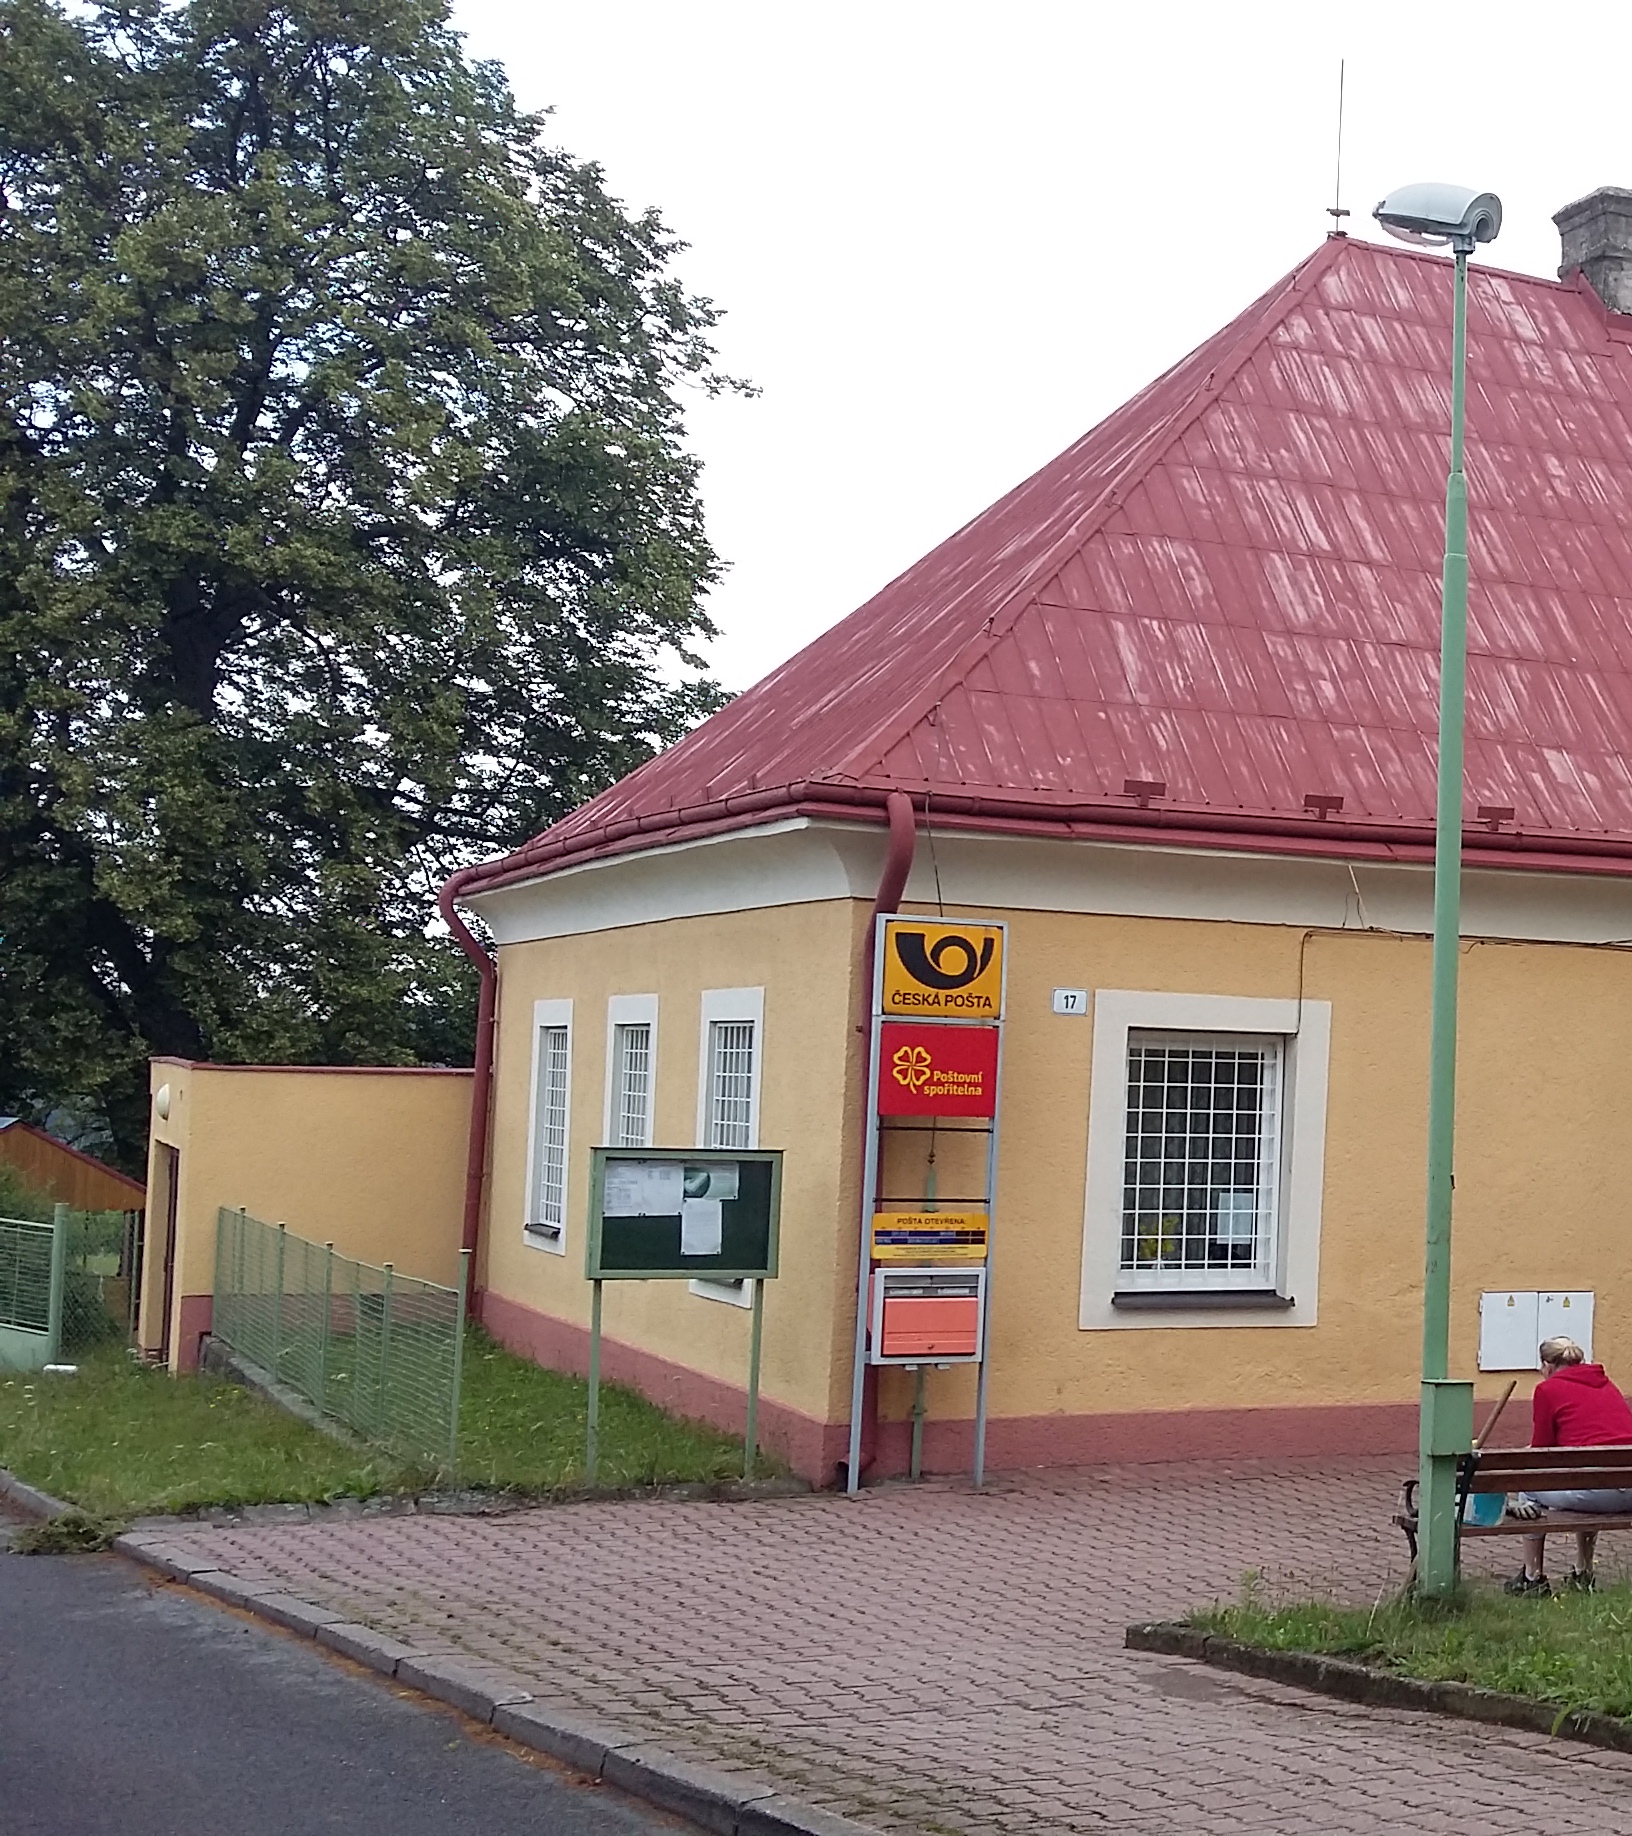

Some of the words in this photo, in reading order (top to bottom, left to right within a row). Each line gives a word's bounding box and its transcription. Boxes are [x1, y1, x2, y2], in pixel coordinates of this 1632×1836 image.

[892, 990, 941, 1006] ČESKÁ
[945, 993, 992, 1008] POŠTA
[1063, 994, 1077, 1009] 17
[933, 1070, 983, 1082] Poštovní
[924, 1083, 982, 1097] spořitelna
[897, 1217, 922, 1225] POŠTA
